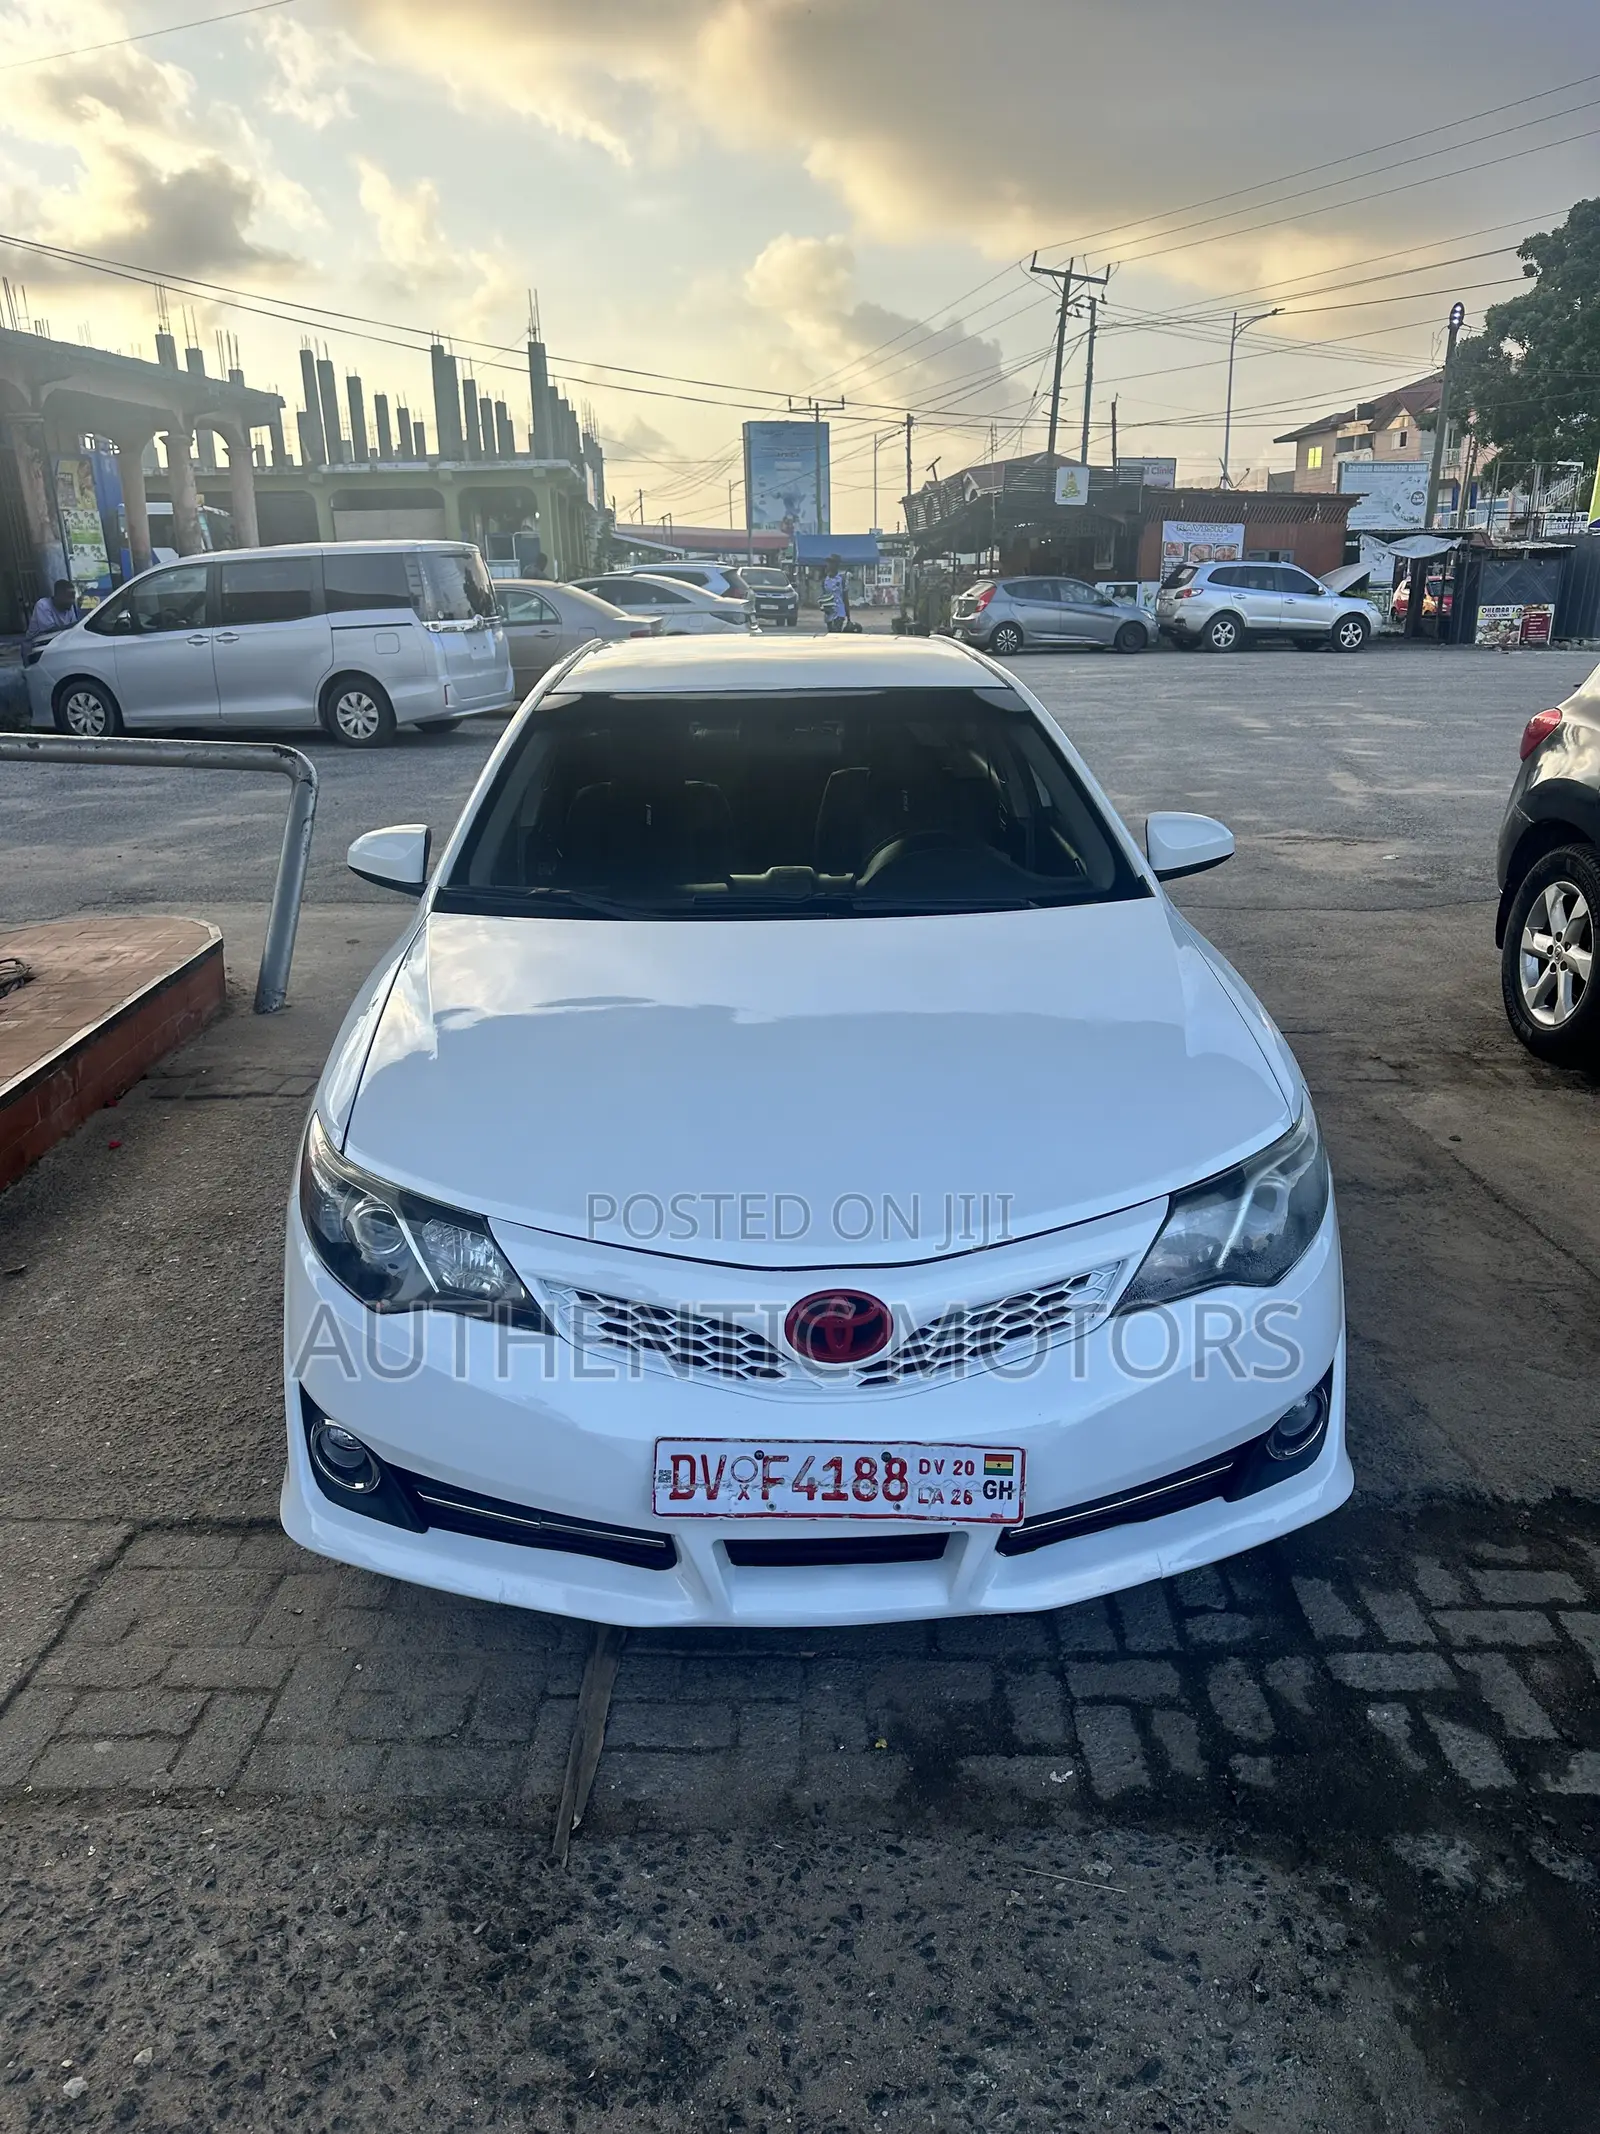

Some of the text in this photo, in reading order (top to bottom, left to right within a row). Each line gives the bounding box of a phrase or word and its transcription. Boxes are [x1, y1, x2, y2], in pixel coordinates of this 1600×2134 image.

[1151, 466, 1174, 475] Clinic
[1373, 464, 1408, 472] DIAGNOSTIC
[918, 1458, 975, 1476] DV 20
[950, 1488, 973, 1505] 26
[983, 1479, 1014, 1500] GH
